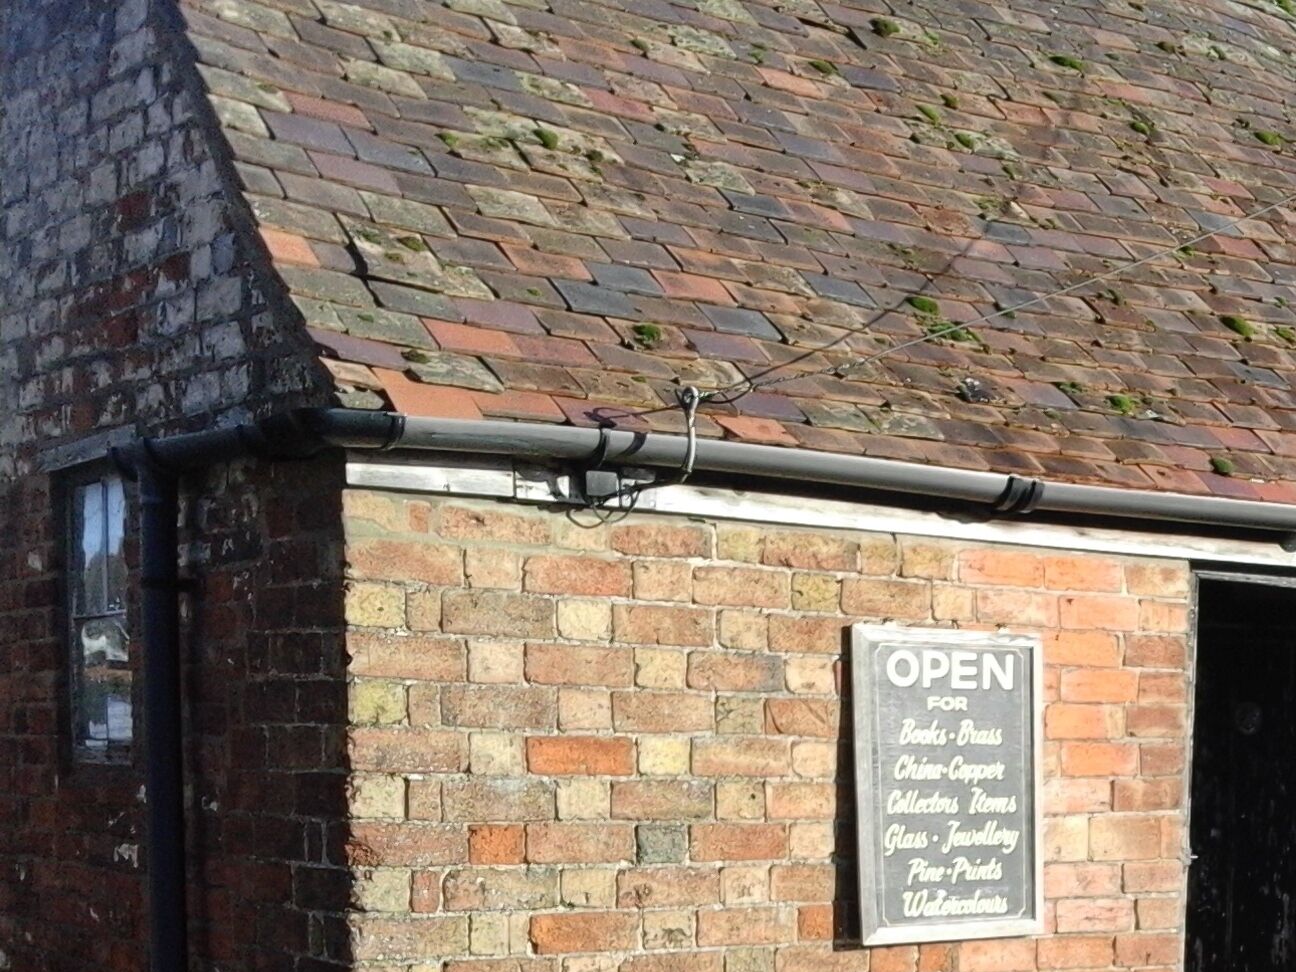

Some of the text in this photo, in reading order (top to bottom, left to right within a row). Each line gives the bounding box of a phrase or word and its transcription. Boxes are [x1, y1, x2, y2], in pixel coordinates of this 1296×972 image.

[886, 650, 1014, 690] OPEN
[927, 696, 968, 711] FOR
[900, 718, 1002, 746] Books Brass
[894, 755, 1005, 784] China Copper
[887, 787, 1017, 815] Collectors Items
[884, 820, 1020, 857] Glass Jewellery
[907, 857, 1002, 886] Pine Prints
[902, 888, 1008, 917] Watercolours
